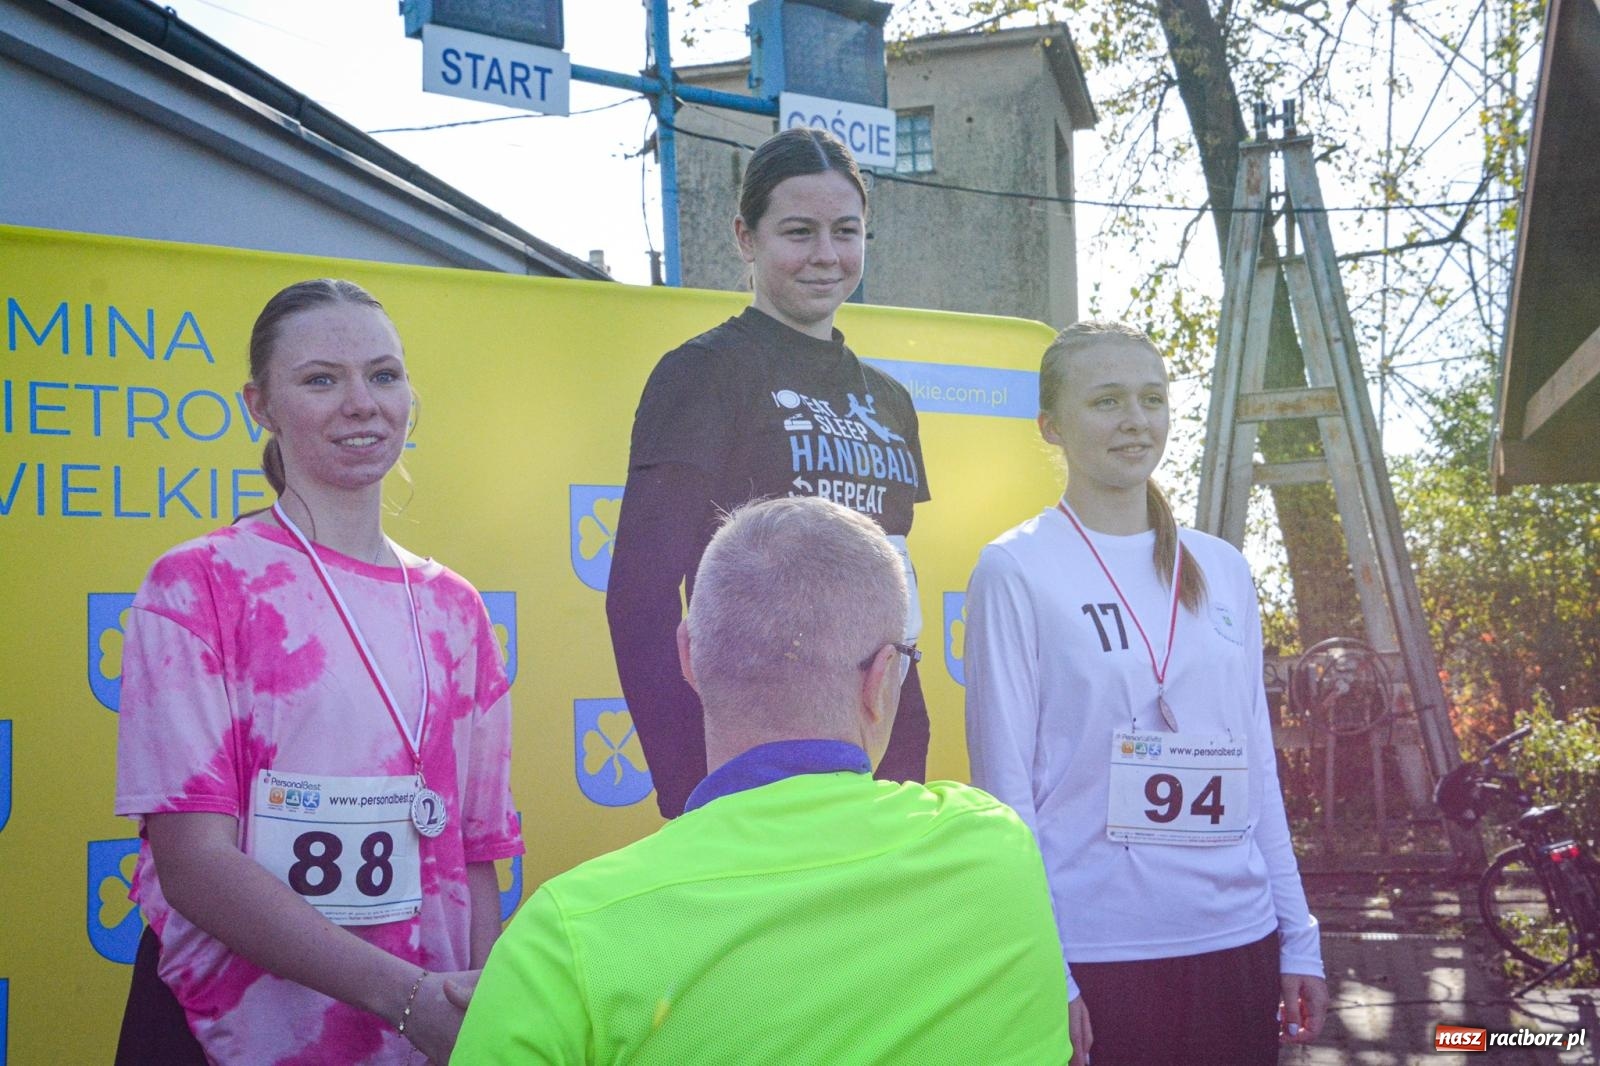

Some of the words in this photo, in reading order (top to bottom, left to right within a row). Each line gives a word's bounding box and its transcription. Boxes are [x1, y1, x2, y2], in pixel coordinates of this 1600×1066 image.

[441, 48, 553, 101] START
[805, 397, 838, 418] EAT
[904, 380, 1008, 407] lkie.com.pl
[814, 414, 869, 442] SLEEP
[818, 479, 887, 514] REPEAT
[1081, 603, 1129, 652] 17
[1169, 746, 1243, 758] www.personalbest.pl
[271, 776, 321, 791] PersonalBest
[422, 798, 438, 825] 2
[1144, 773, 1225, 825] 94
[288, 831, 394, 896] 88
